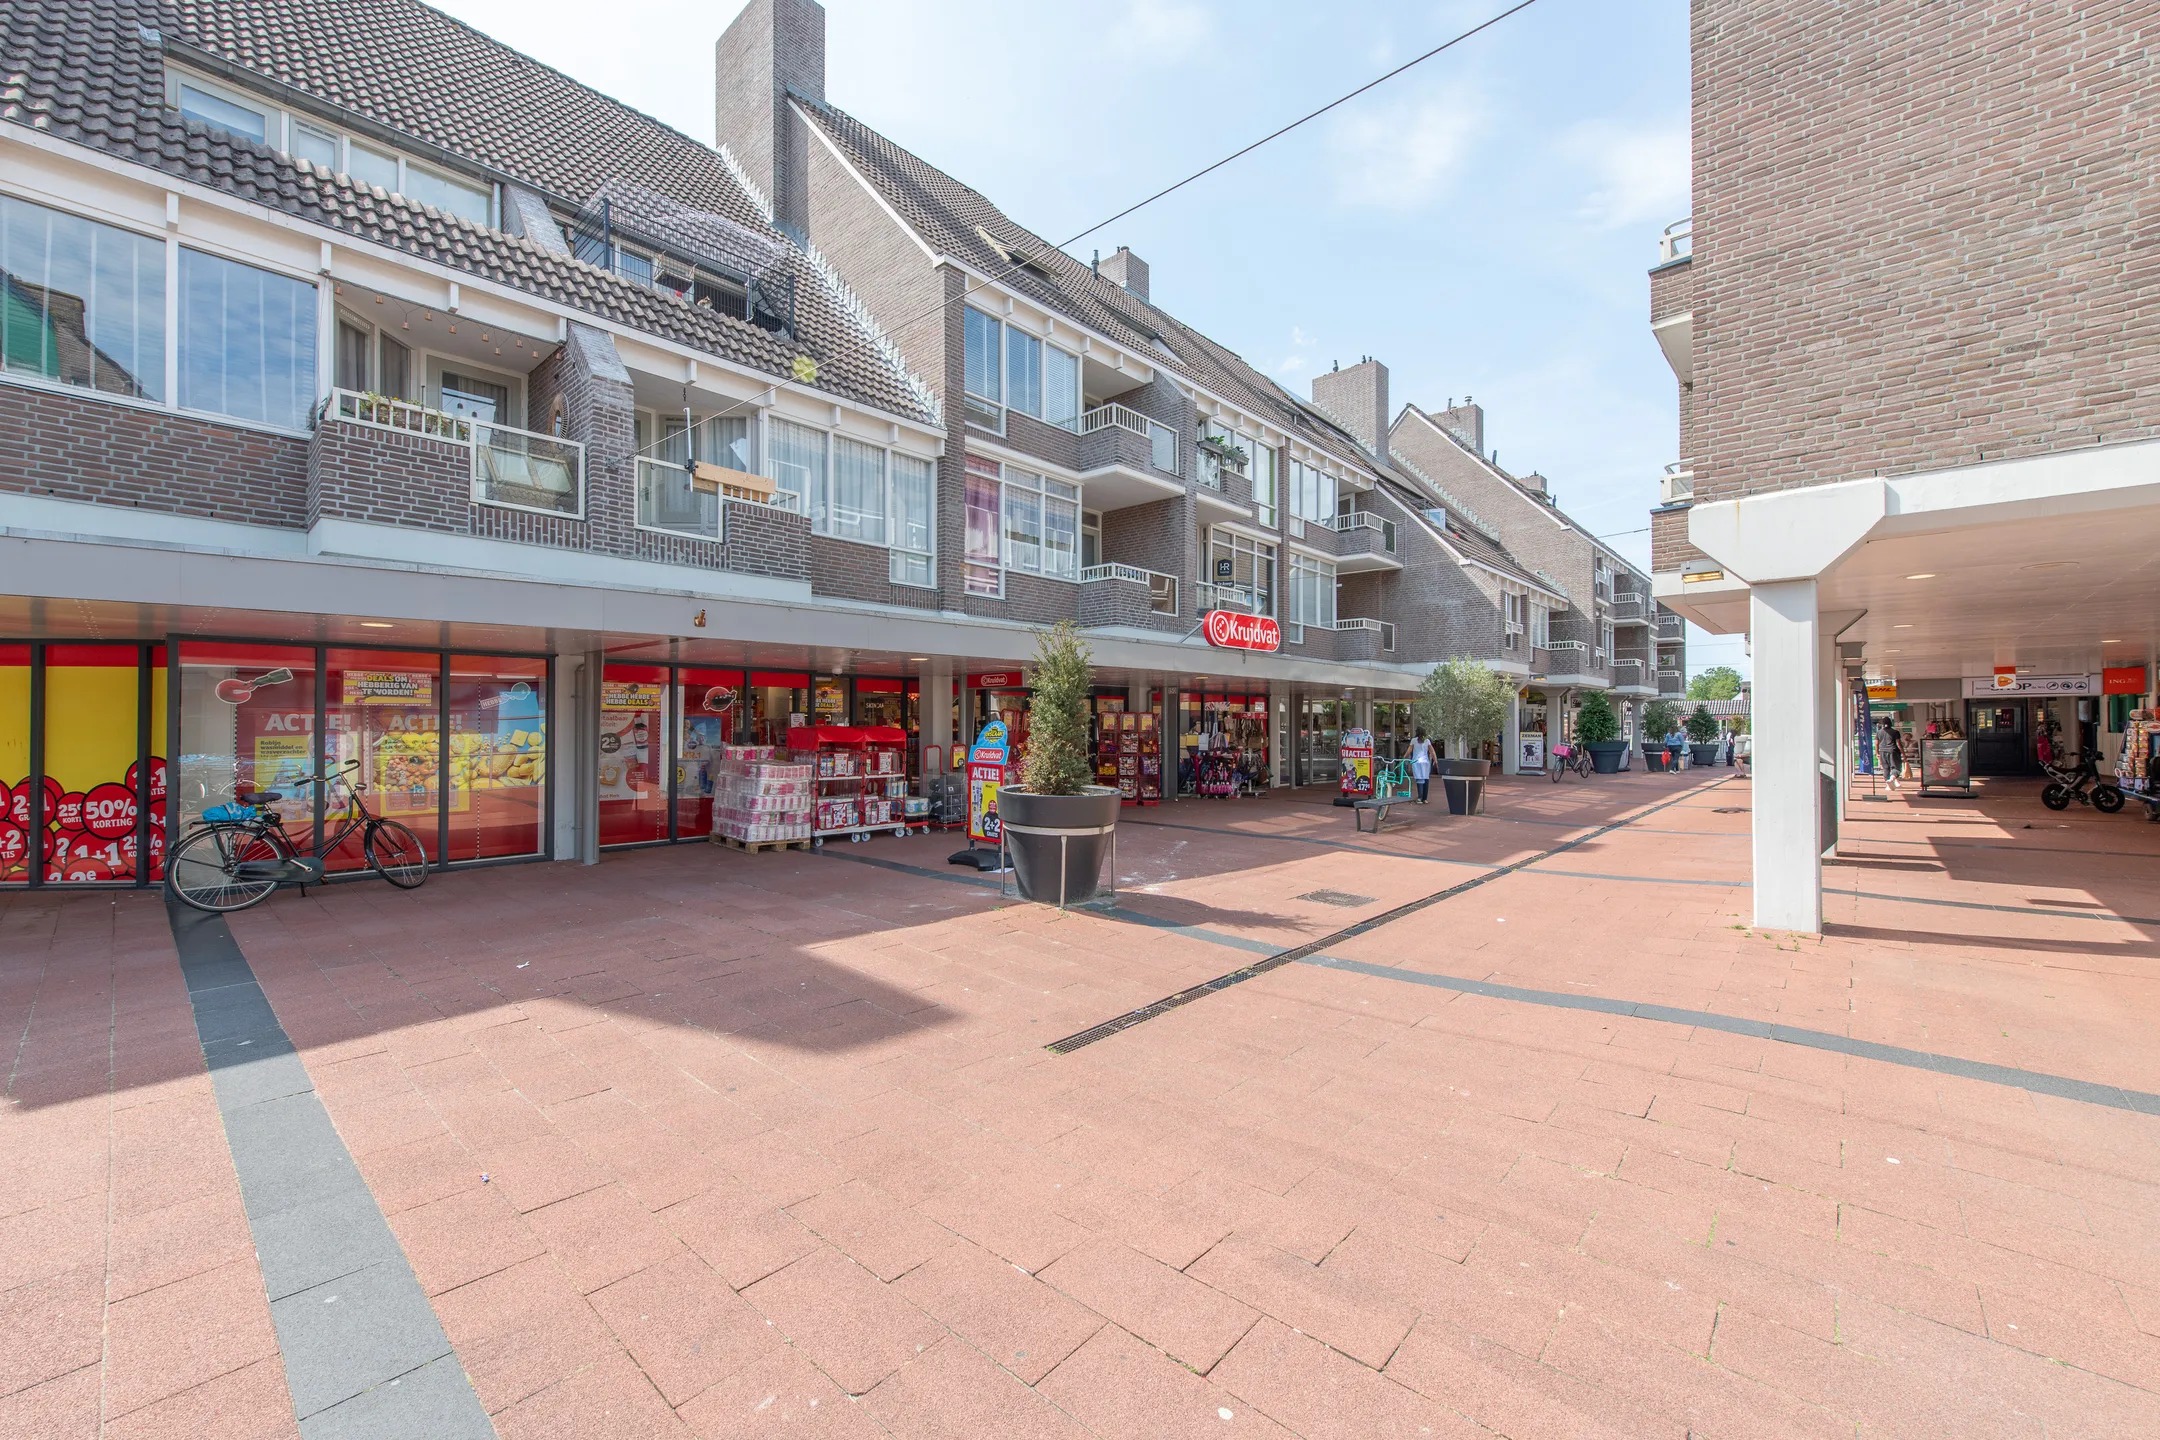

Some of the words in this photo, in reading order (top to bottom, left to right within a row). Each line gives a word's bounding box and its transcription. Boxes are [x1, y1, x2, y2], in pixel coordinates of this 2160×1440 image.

[1230, 620, 1278, 645] Kruidvat
[264, 713, 351, 731] ACTE!
[981, 751, 1002, 759] Kruidvat
[972, 767, 999, 780] ACTIE!
[86, 798, 138, 820] 50%
[62, 814, 82, 823] KORTI
[93, 818, 133, 829] KORTING
[984, 817, 1001, 832] 2+2
